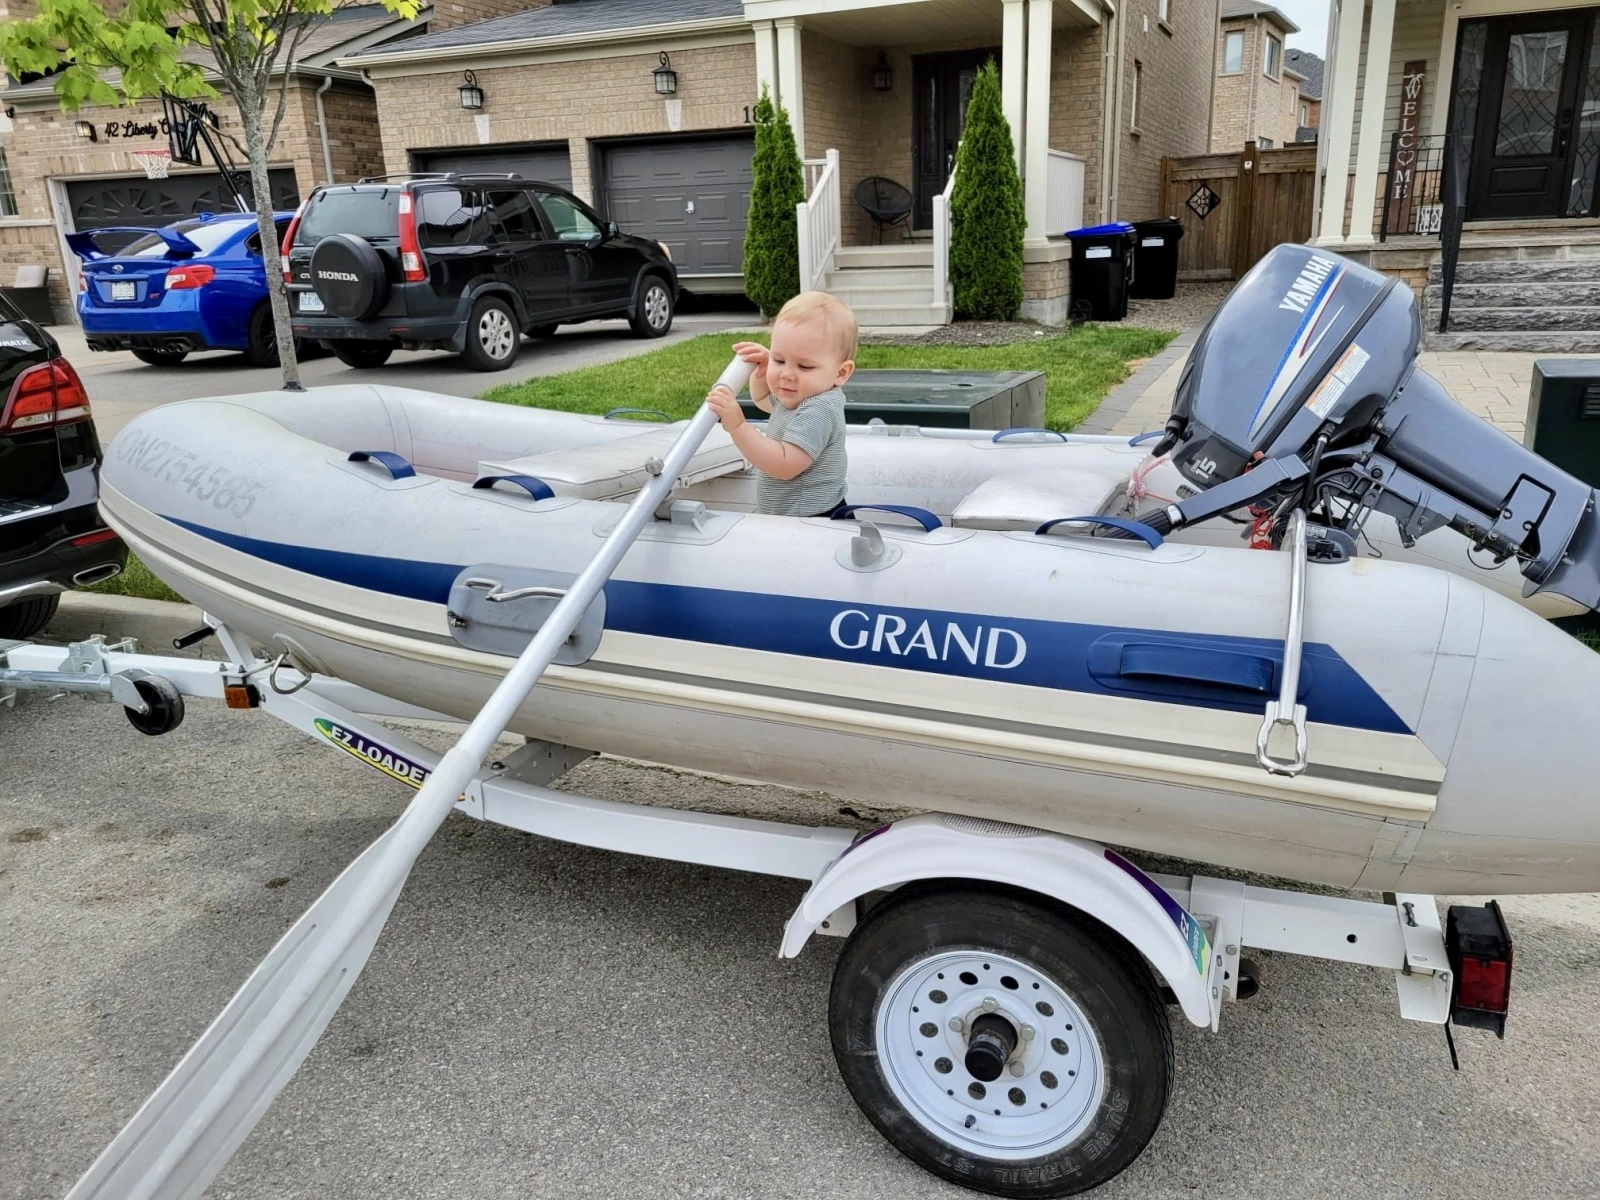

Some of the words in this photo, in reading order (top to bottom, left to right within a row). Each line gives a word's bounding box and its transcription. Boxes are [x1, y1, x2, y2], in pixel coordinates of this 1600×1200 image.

[104, 122, 120, 138] 42
[121, 120, 158, 140] Liberty
[317, 270, 360, 282] HONDA
[1278, 254, 1336, 314] YAMAHA
[0, 339, 31, 347] MATIC
[1195, 456, 1217, 479] 15
[829, 608, 1028, 670] GRAND
[330, 725, 354, 748] EZ
[1180, 911, 1190, 942] EZ
[1081, 1090, 1130, 1161] SURE
[934, 1155, 976, 1175] ST
[993, 1155, 1081, 1184] TRAIL
